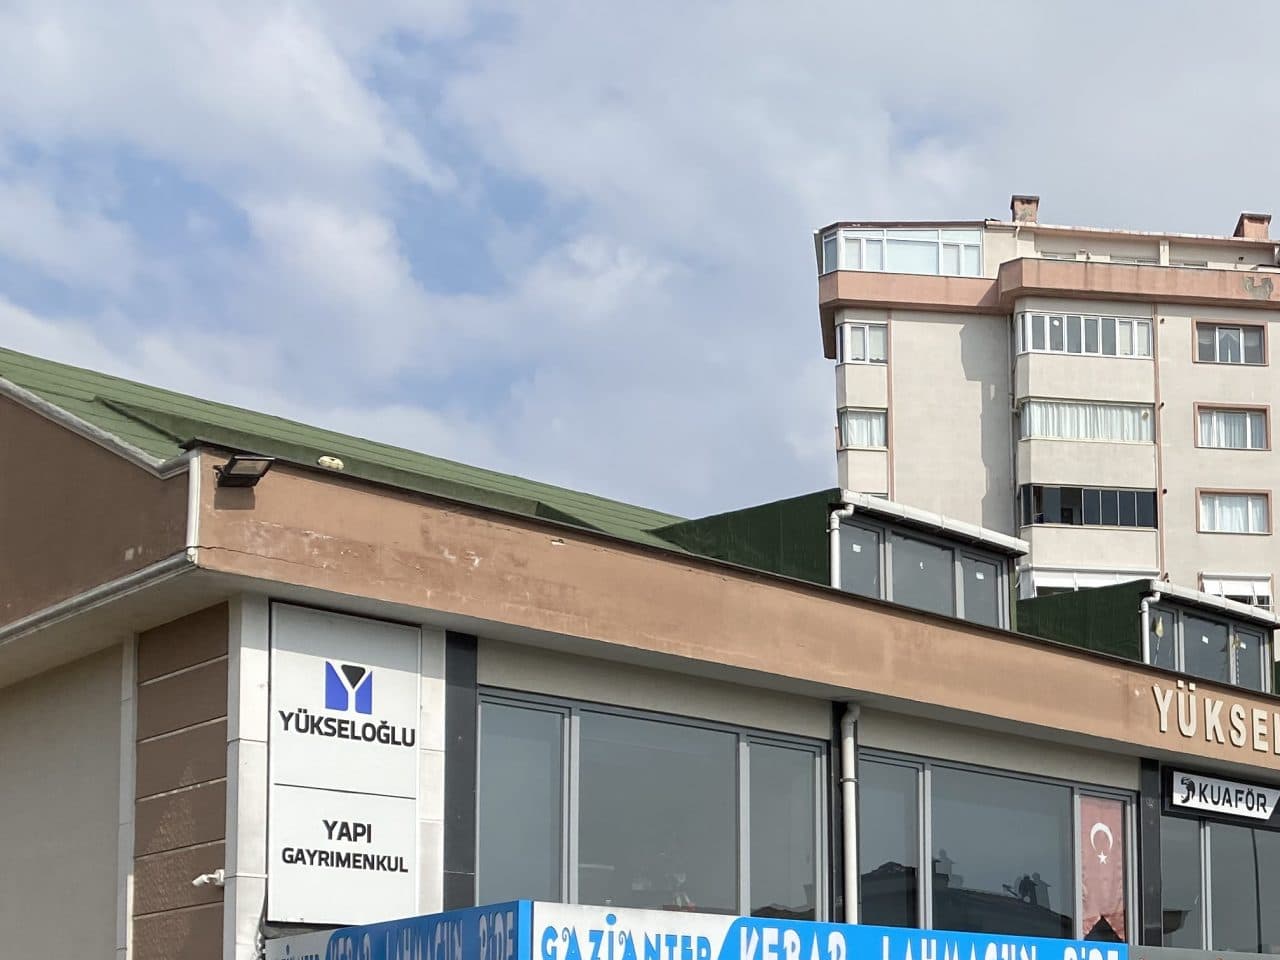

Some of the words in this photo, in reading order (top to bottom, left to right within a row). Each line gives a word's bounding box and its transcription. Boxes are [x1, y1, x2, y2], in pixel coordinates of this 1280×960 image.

[278, 708, 416, 747] YÜKSELOĞLU
[1198, 783, 1268, 814] KUAFÖR
[322, 819, 372, 843] YAPI
[281, 846, 409, 873] GAYRIMENKUL
